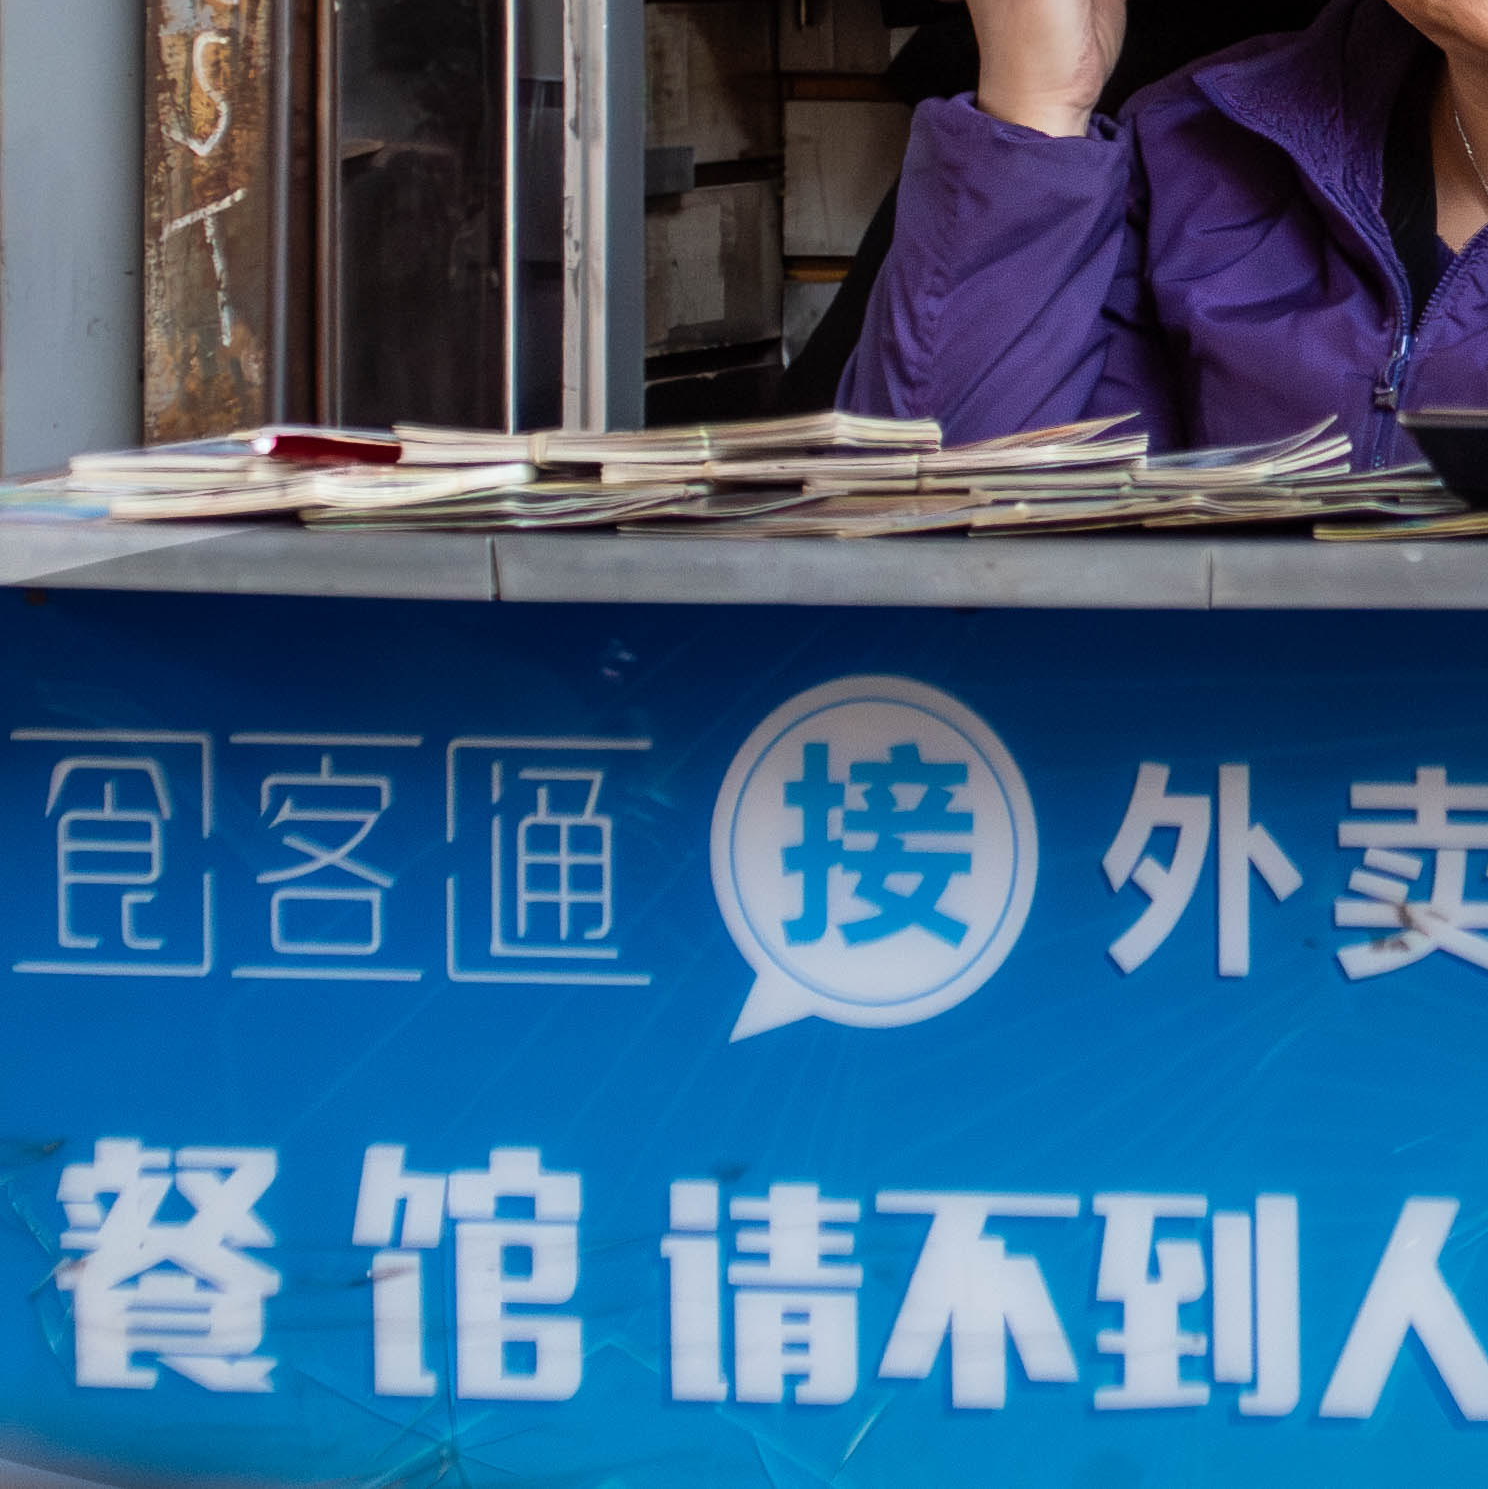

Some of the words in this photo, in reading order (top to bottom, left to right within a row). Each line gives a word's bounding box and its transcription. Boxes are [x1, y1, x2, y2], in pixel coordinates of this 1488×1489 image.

[9, 727, 653, 986] 食客通
[779, 742, 976, 951] 接
